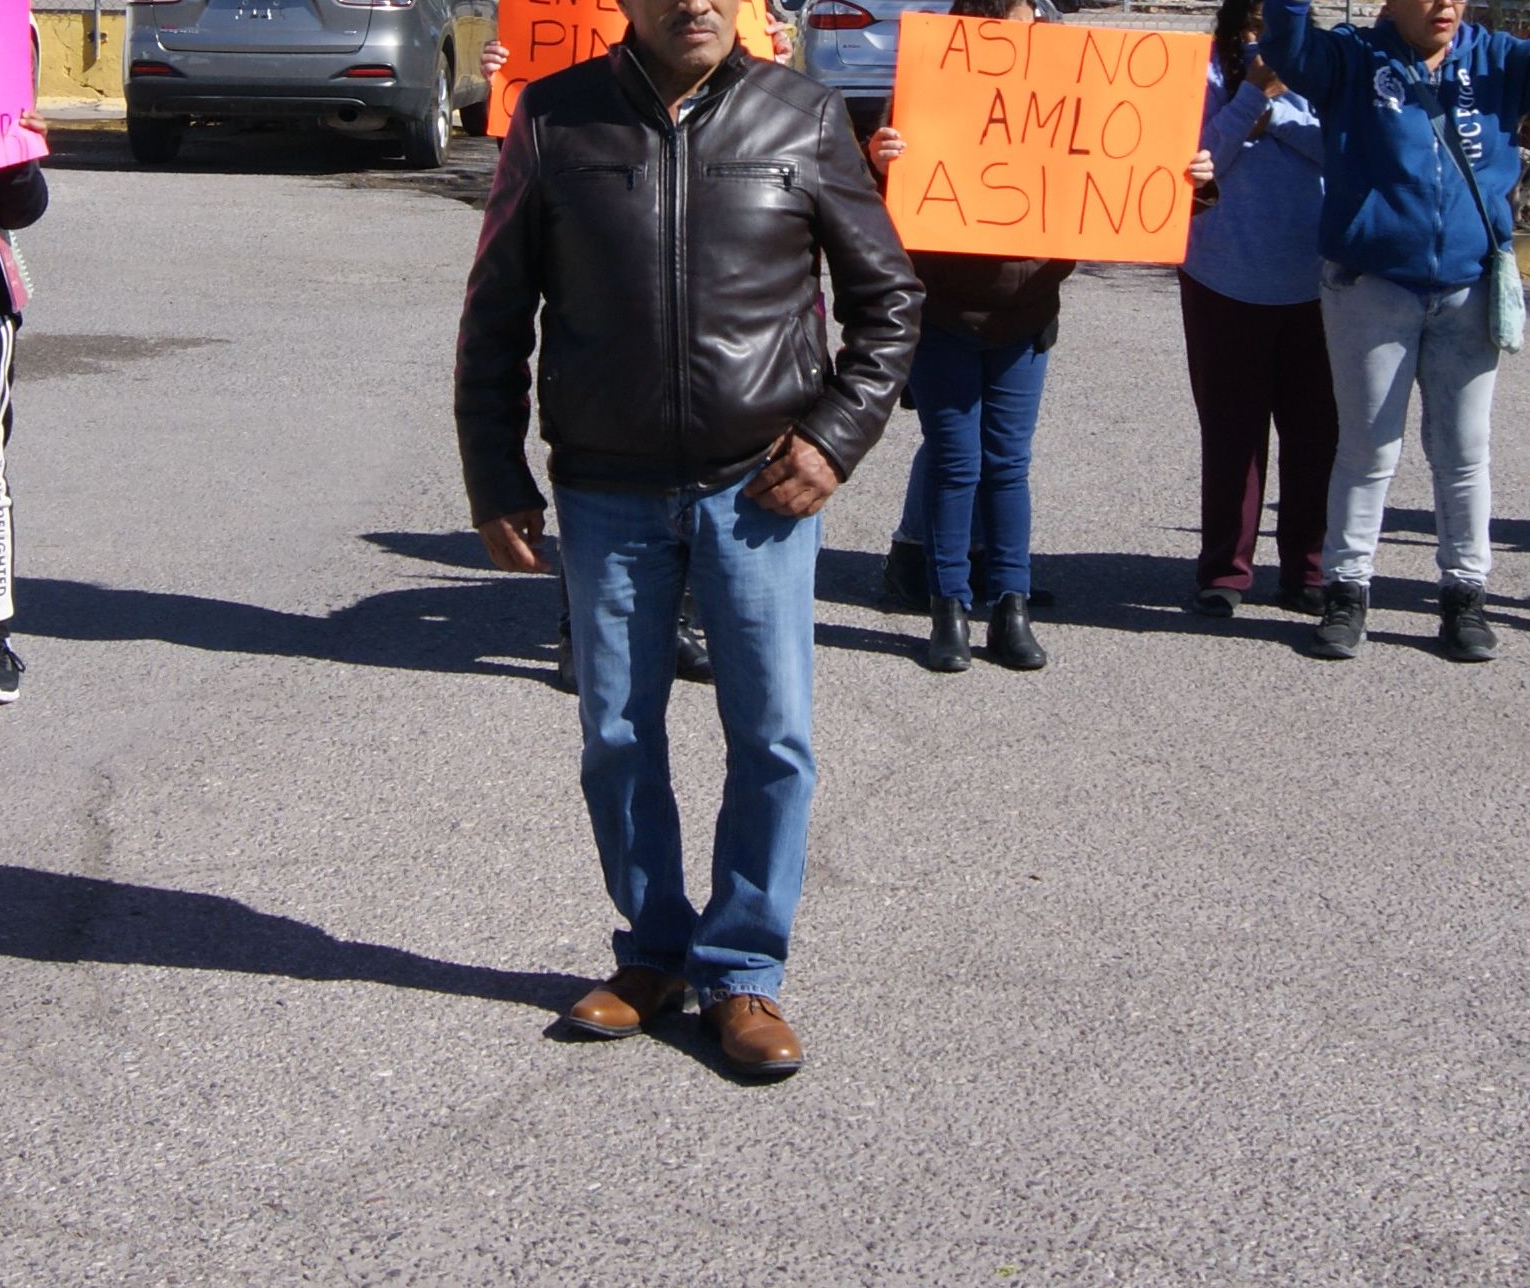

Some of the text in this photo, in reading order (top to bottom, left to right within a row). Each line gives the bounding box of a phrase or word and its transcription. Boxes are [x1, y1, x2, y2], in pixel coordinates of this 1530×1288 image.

[1077, 32, 1169, 88] NO
[979, 87, 1142, 159] AMLO
[916, 160, 1176, 234] ASI NO
